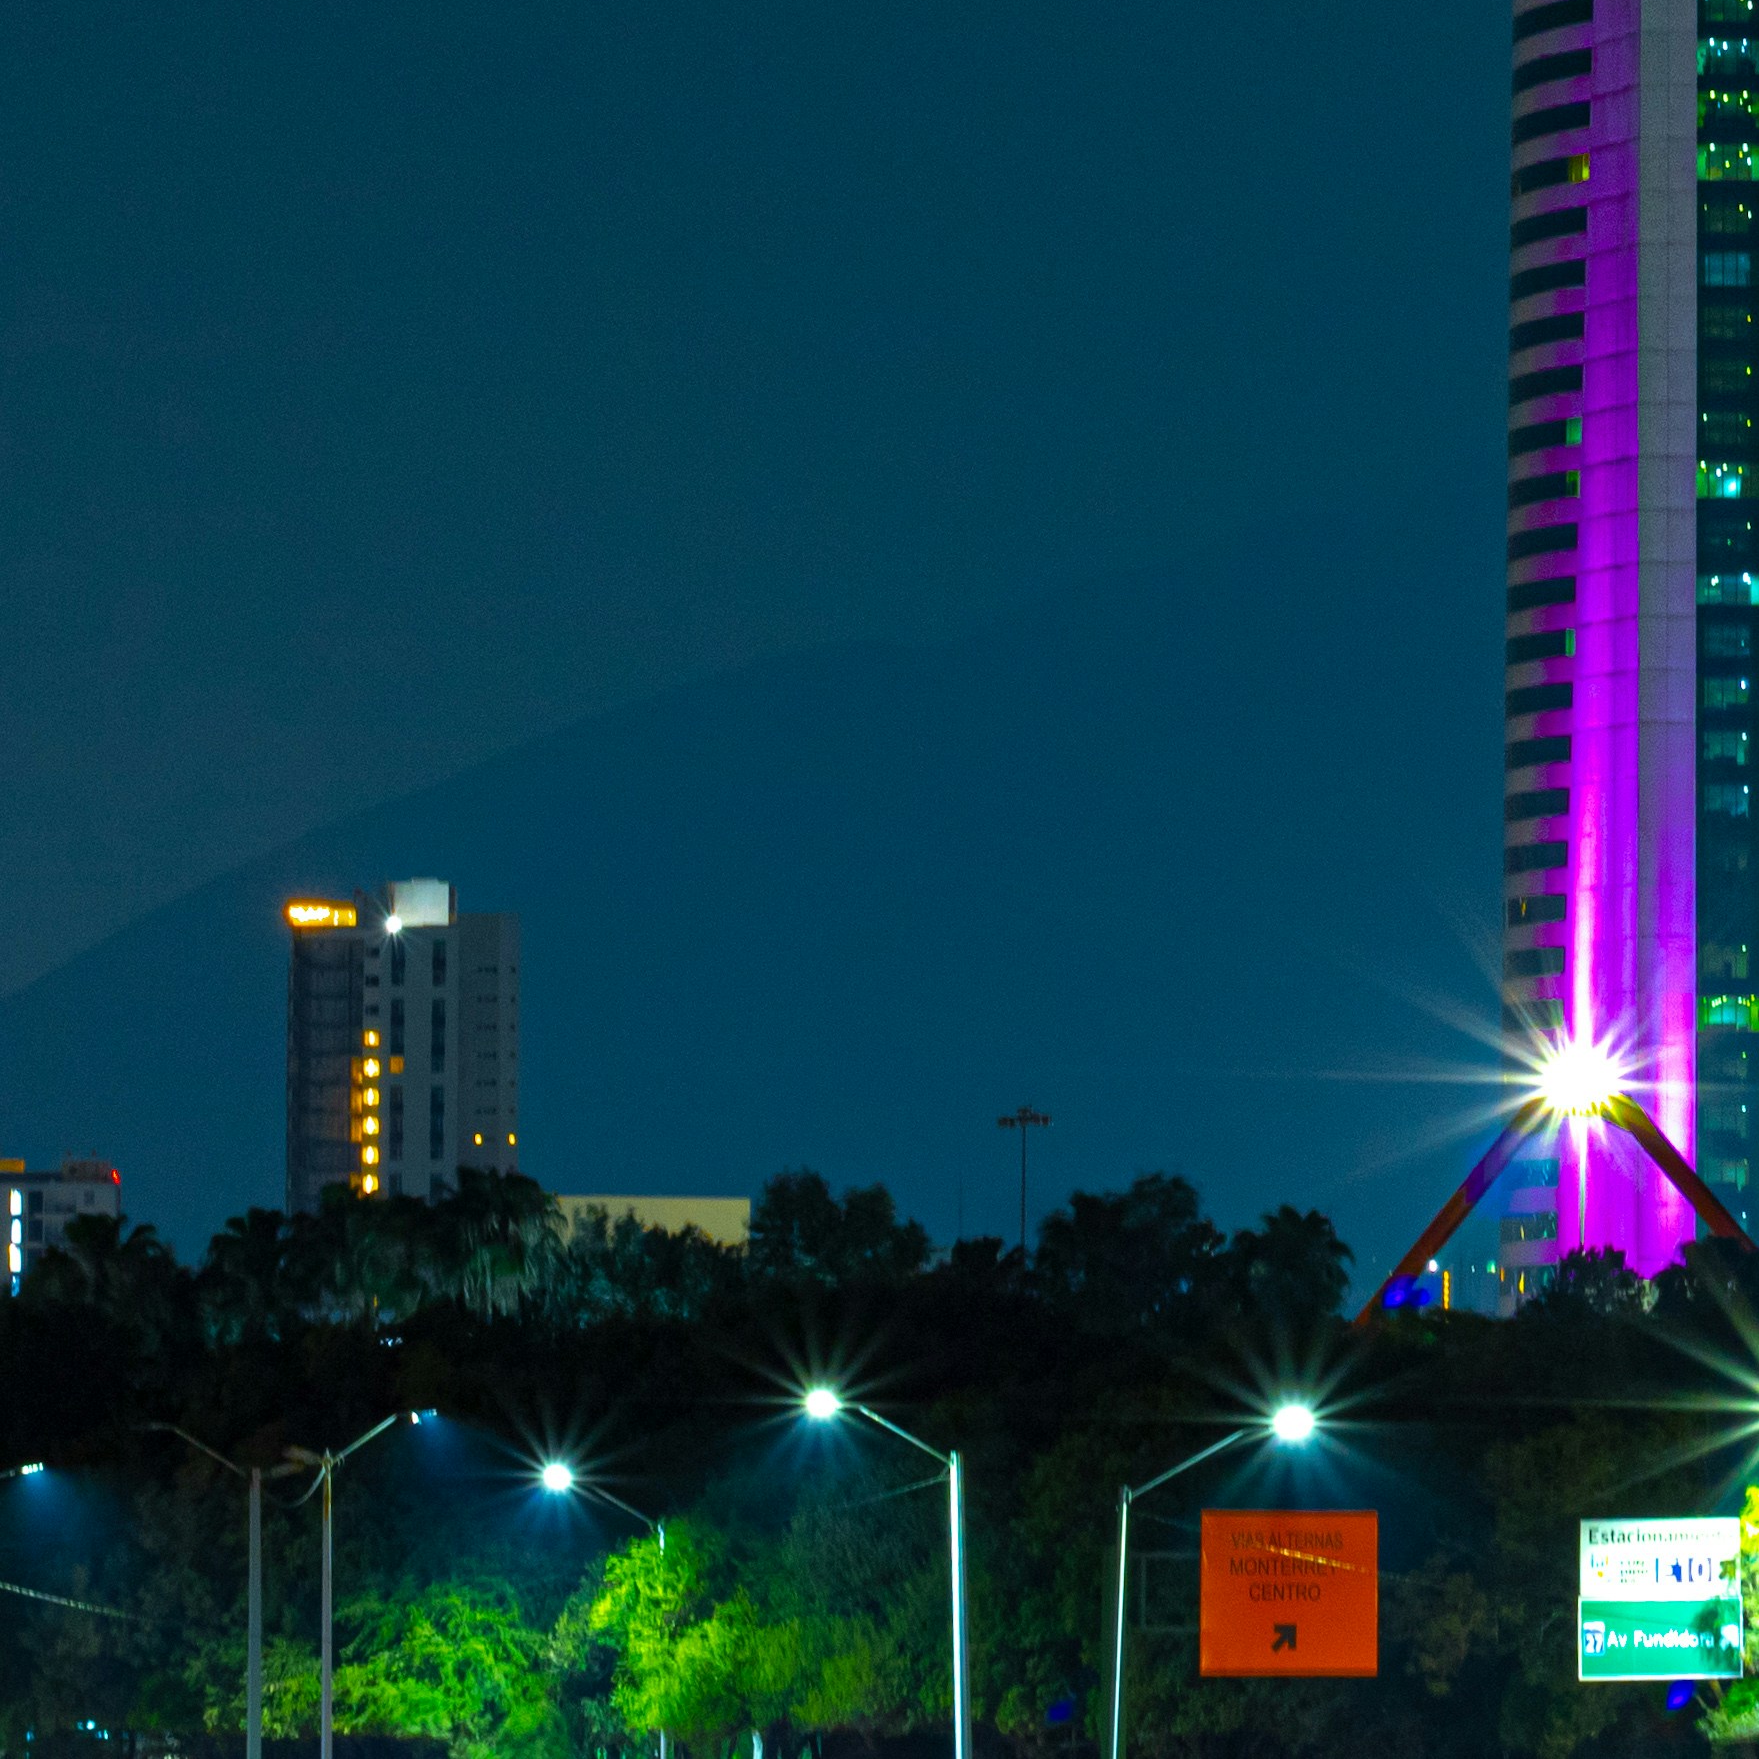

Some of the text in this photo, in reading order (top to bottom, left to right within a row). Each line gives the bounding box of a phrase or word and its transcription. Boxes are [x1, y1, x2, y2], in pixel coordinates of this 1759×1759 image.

[1588, 1527, 1726, 1545] Estacionam
[1248, 1582, 1321, 1602] CENTRO
[1584, 1631, 1604, 1654] 27
[1607, 1630, 1628, 1648] Av
